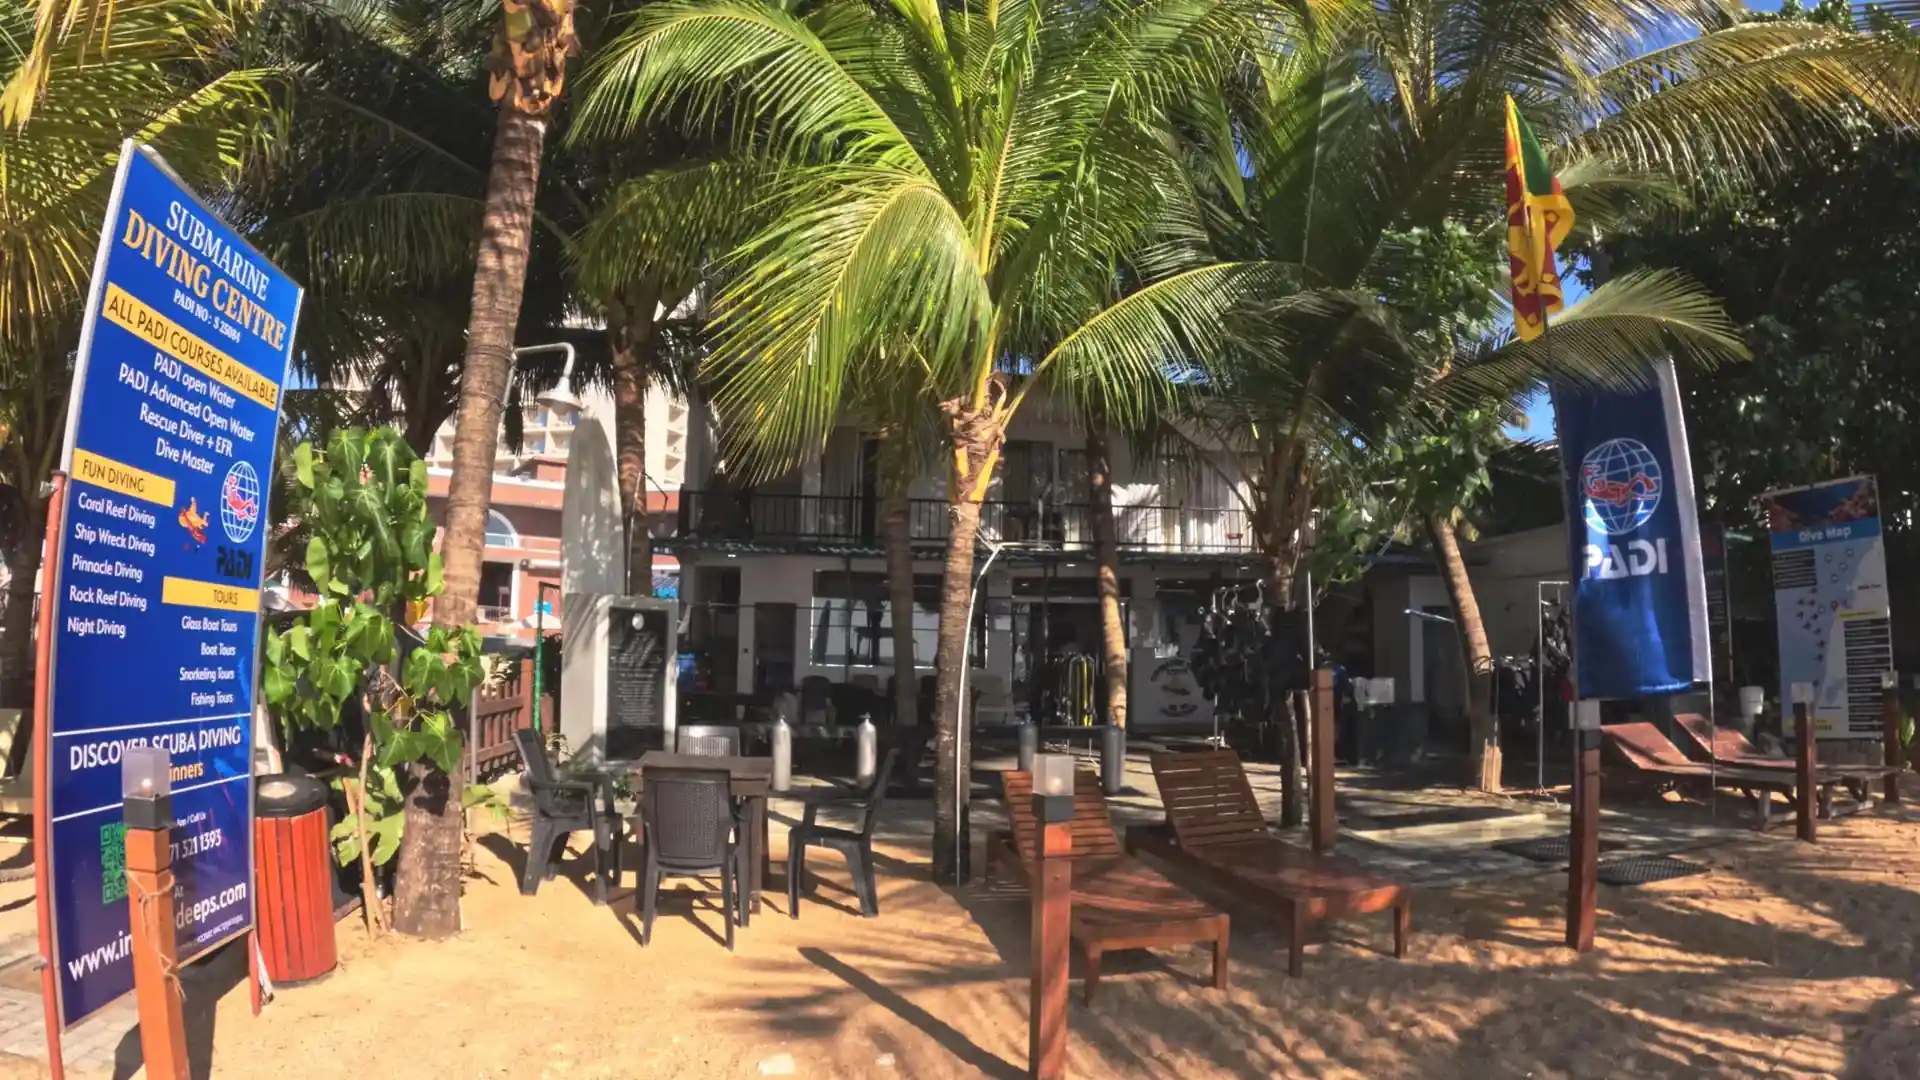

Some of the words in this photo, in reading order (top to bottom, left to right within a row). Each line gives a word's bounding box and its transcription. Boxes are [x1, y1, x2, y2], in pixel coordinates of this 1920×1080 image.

[166, 200, 271, 301] SUBMARINE
[122, 208, 212, 299] DIVING
[212, 278, 287, 351] CENTRE
[173, 288, 196, 314] PADI
[108, 295, 133, 325] ALL
[136, 309, 169, 343] PADI
[170, 331, 224, 375] COURSES
[224, 364, 277, 405] AVAILABLE
[154, 352, 182, 383] PADI
[182, 373, 207, 396] open
[208, 380, 236, 409] Water
[118, 362, 149, 394] PADI
[149, 379, 201, 418] Advanced
[202, 405, 228, 432] Open
[229, 415, 256, 442] Water
[139, 402, 178, 435] Rescue
[179, 420, 205, 447] Diver
[215, 436, 233, 457] EFR
[155, 437, 180, 463] Dive
[180, 447, 215, 475] Master
[82, 459, 105, 480] FUN
[107, 468, 145, 493] DIVING
[78, 492, 104, 514] Coral
[105, 500, 127, 519] Reef
[128, 505, 156, 529] Diving
[74, 522, 97, 545] Ship
[98, 527, 127, 549] Wreck
[128, 534, 156, 557] Diving
[72, 553, 113, 576] Pinnacle
[114, 561, 143, 583] Diving
[216, 545, 252, 579] PADI
[1582, 538, 1669, 580] PADI
[69, 585, 95, 603] Rock
[96, 588, 119, 606] Reef
[119, 591, 147, 612] Diving
[213, 589, 239, 605] TOURS
[67, 616, 95, 637] Night
[96, 618, 126, 639] Diving
[181, 615, 202, 630] Glass
[202, 617, 220, 631] Boat
[221, 618, 238, 632] Tours
[201, 642, 218, 656] Boat
[219, 642, 236, 656] Tours
[179, 667, 217, 683] Snorkeling
[217, 666, 235, 680] Tours
[191, 692, 215, 708] Fishing
[216, 691, 234, 704] Tours
[152, 732, 196, 755] SCUBA
[199, 726, 241, 750] DIVING
[169, 762, 204, 782] inners
[199, 828, 222, 852] 1393
